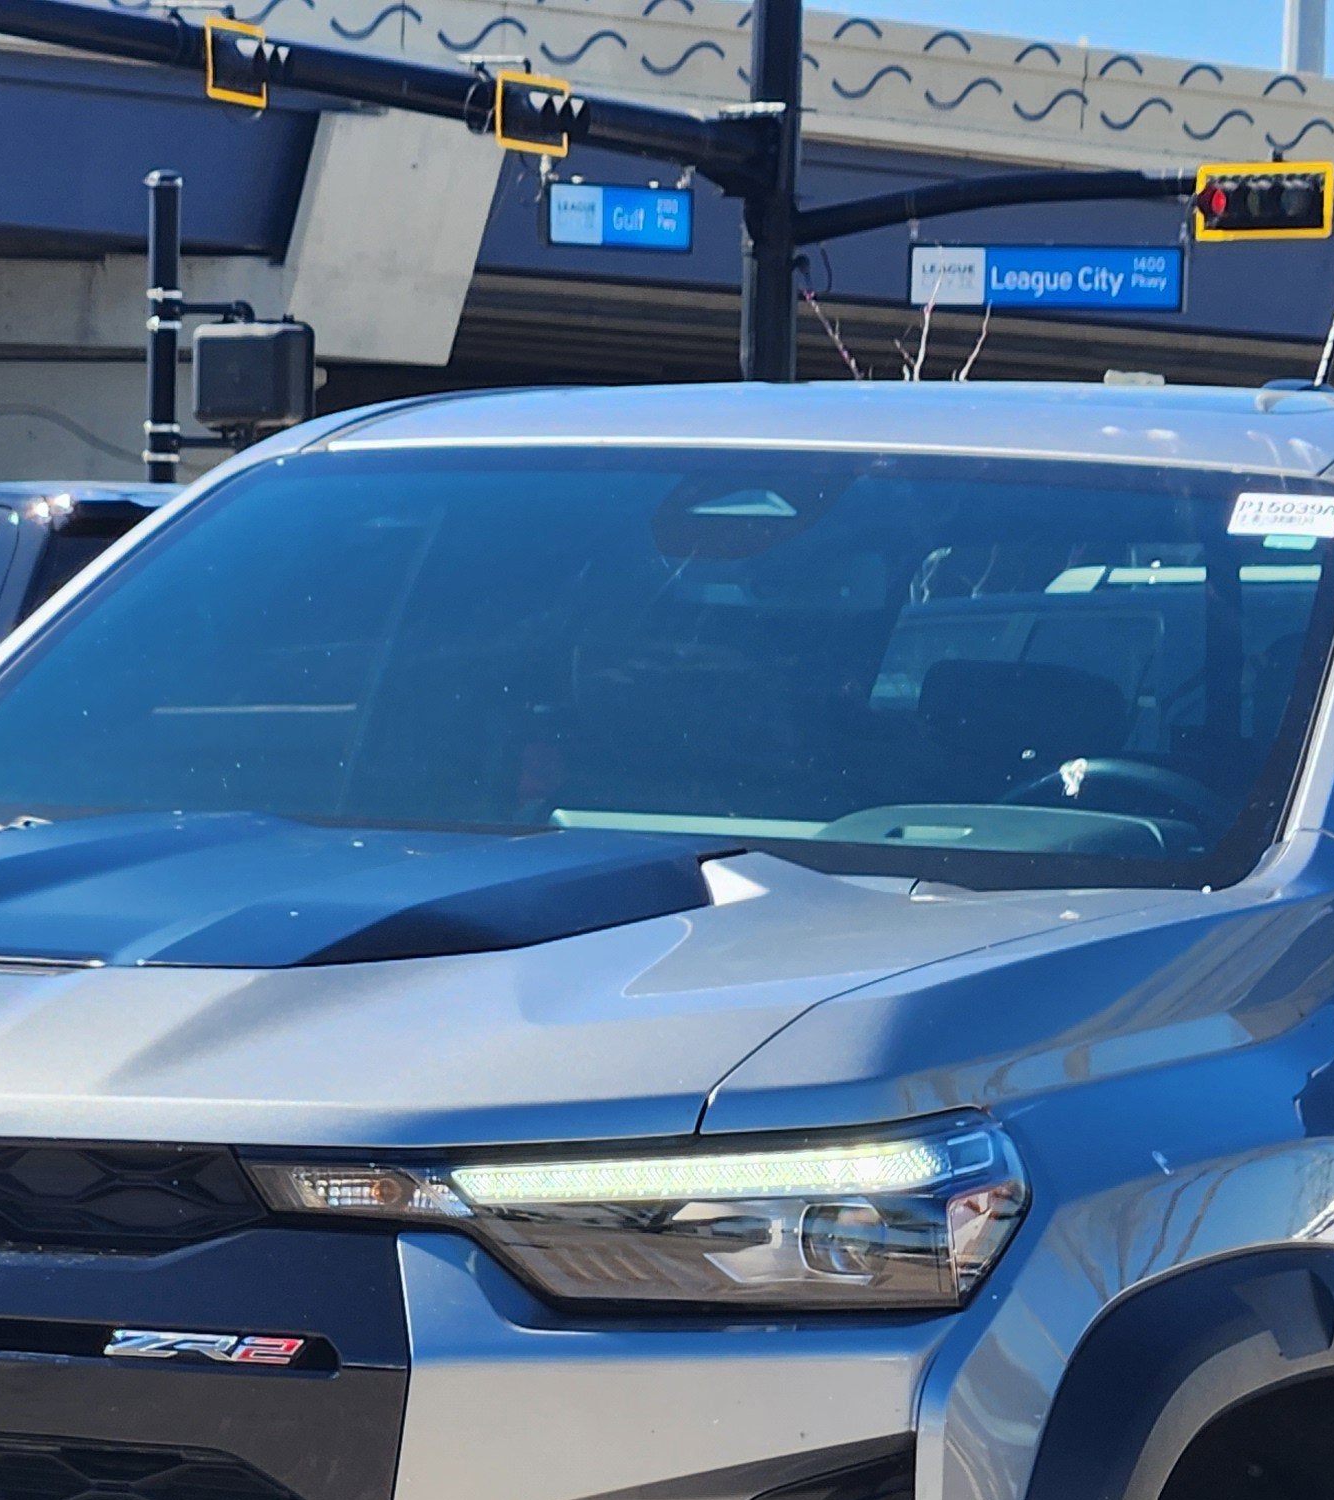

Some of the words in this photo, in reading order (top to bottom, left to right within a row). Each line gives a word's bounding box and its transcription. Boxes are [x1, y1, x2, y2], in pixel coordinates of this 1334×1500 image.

[613, 207, 645, 231] Gulf
[1133, 256, 1166, 272] 1400
[991, 265, 1073, 298] League
[1078, 266, 1125, 298] City
[103, 1329, 305, 1365] ZR2
